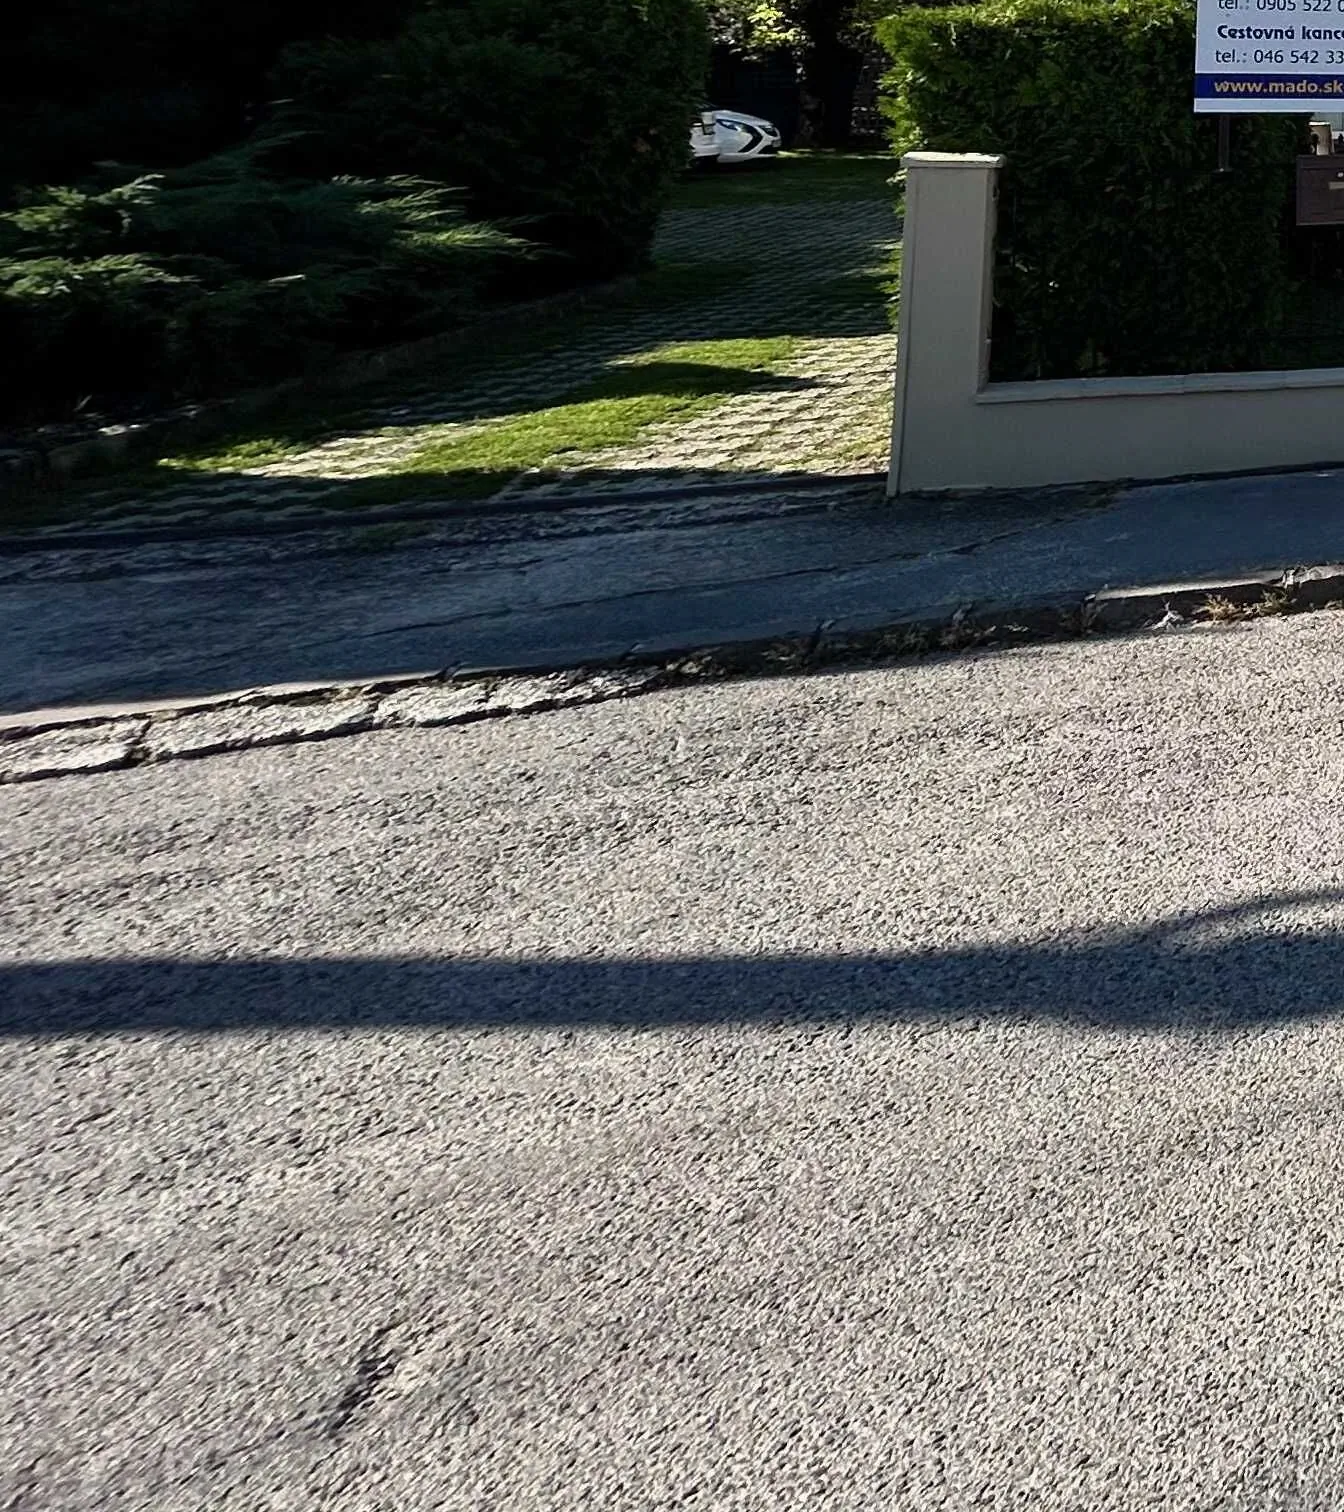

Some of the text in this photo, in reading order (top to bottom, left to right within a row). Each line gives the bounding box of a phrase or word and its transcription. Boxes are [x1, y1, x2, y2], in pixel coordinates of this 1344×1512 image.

[1217, 24, 1295, 40] Cestovná
[1215, 48, 1247, 63] tel.:
[1253, 49, 1284, 64] 046
[1290, 49, 1319, 64] 542
[1214, 79, 1344, 94] www.mado.sk
